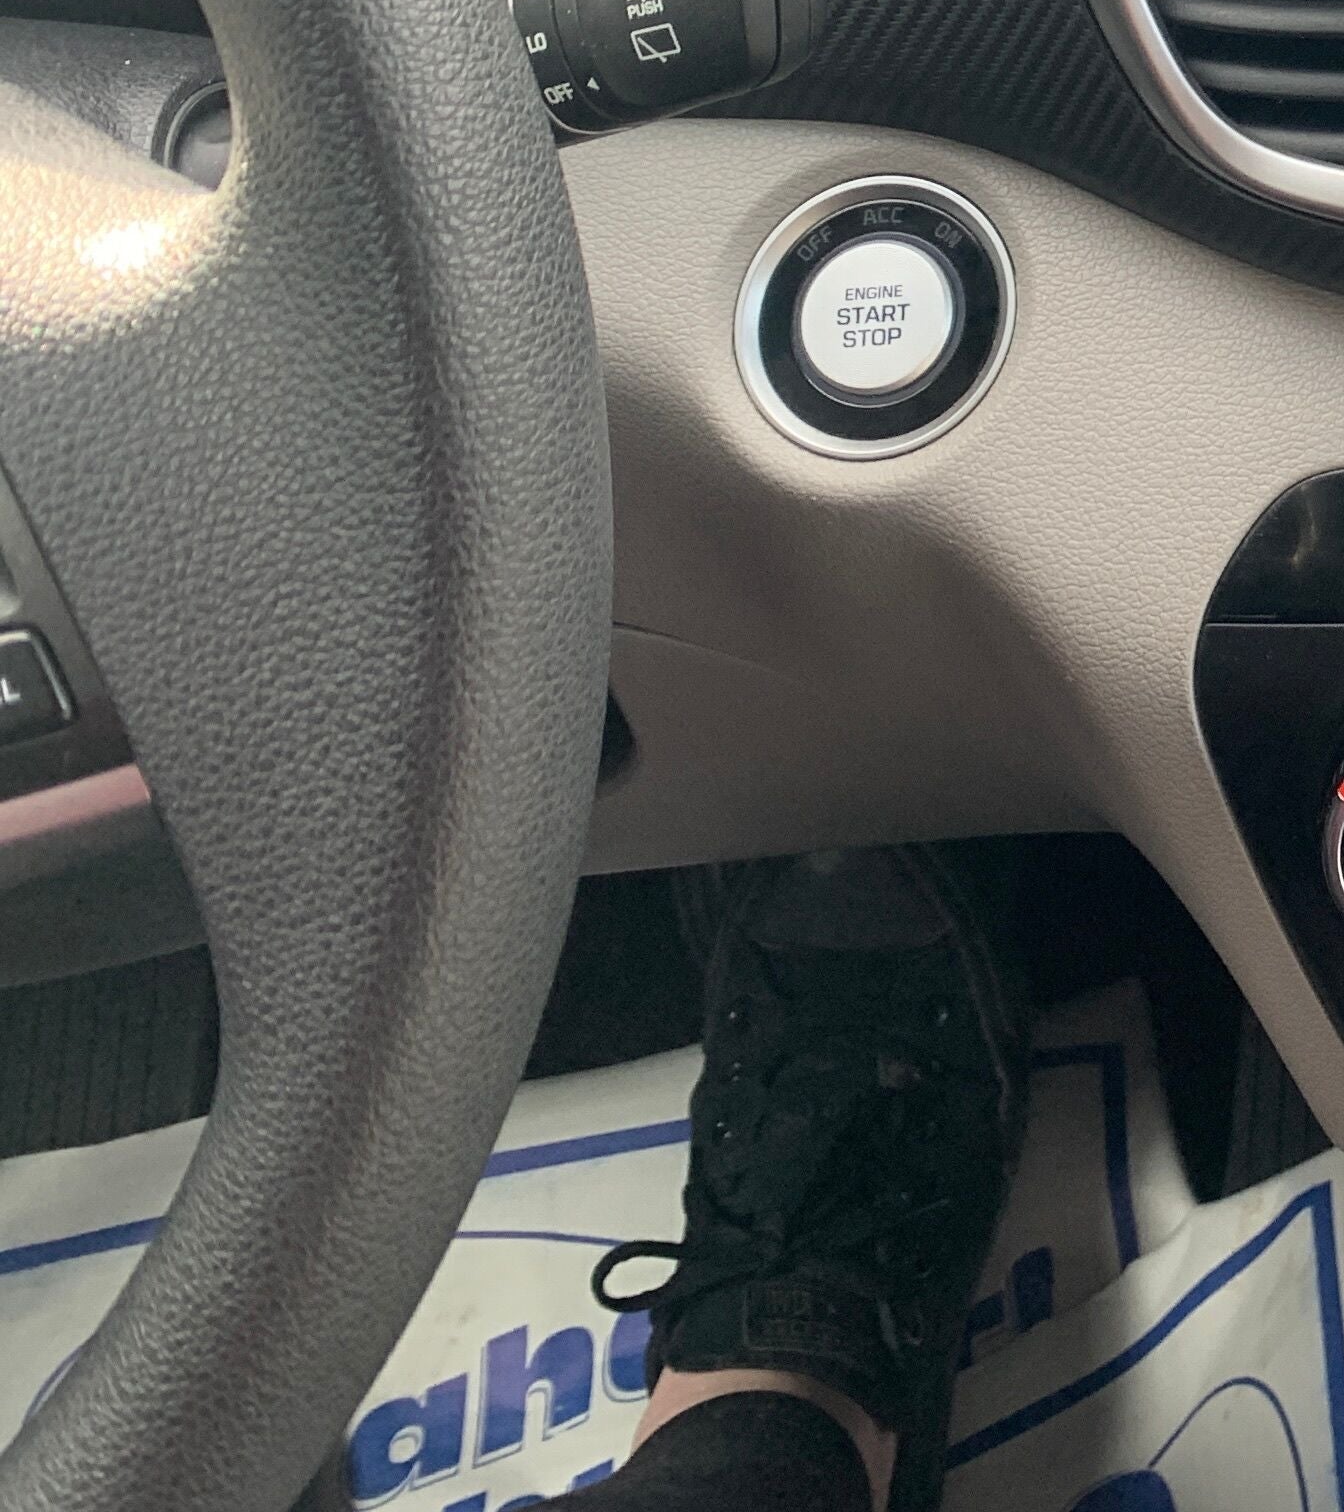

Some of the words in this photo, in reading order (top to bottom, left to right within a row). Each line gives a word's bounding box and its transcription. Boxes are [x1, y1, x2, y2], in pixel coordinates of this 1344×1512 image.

[526, 32, 548, 55] LO
[543, 82, 574, 105] OFF
[863, 207, 904, 226] ACC
[796, 226, 833, 262] OFF
[934, 220, 963, 250] ON
[845, 285, 903, 301] ENGINE
[836, 303, 911, 325] START
[842, 327, 902, 348] STOP
